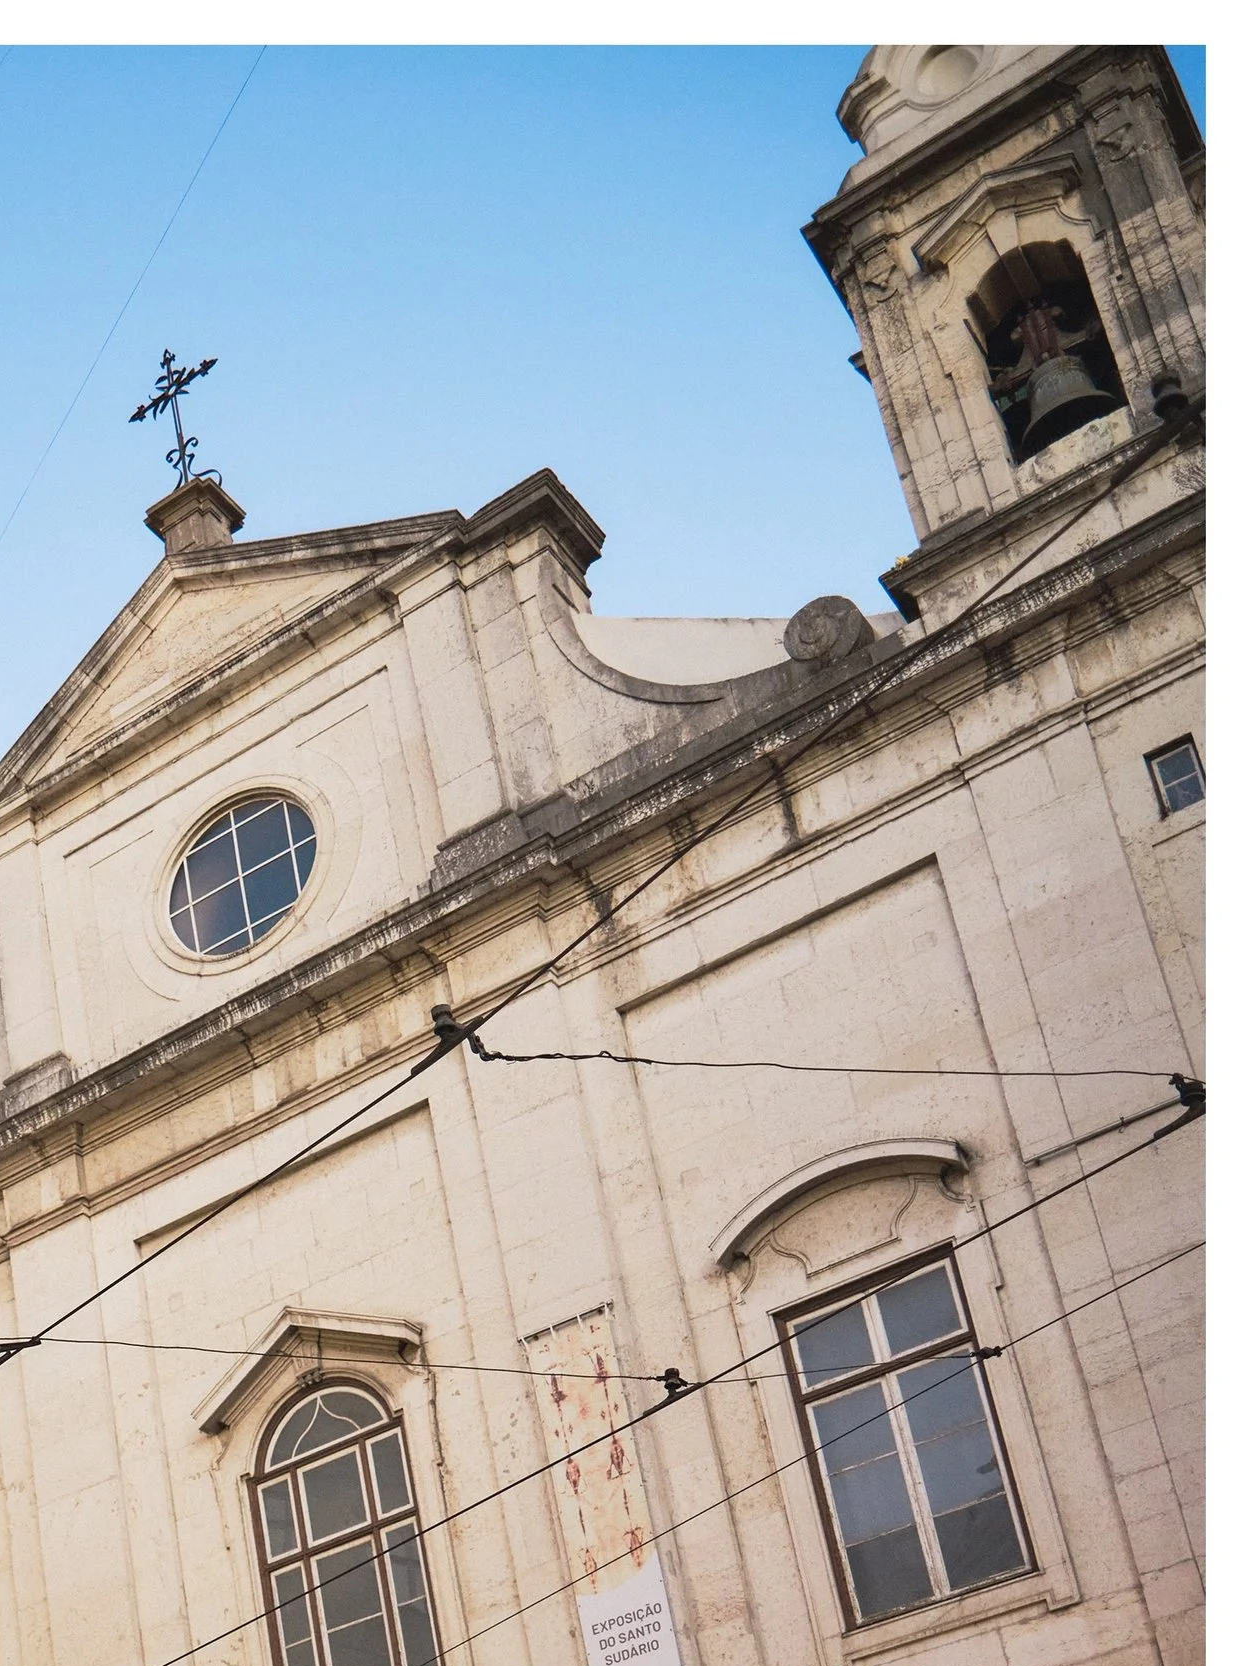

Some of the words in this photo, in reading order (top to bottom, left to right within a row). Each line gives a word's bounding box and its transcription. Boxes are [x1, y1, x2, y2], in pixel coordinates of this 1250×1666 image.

[591, 1602, 662, 1635] EXPOSIÇÃO
[599, 1636, 616, 1651] DO
[618, 1621, 661, 1644] SANTO
[604, 1639, 660, 1666] SUDÁRIO
